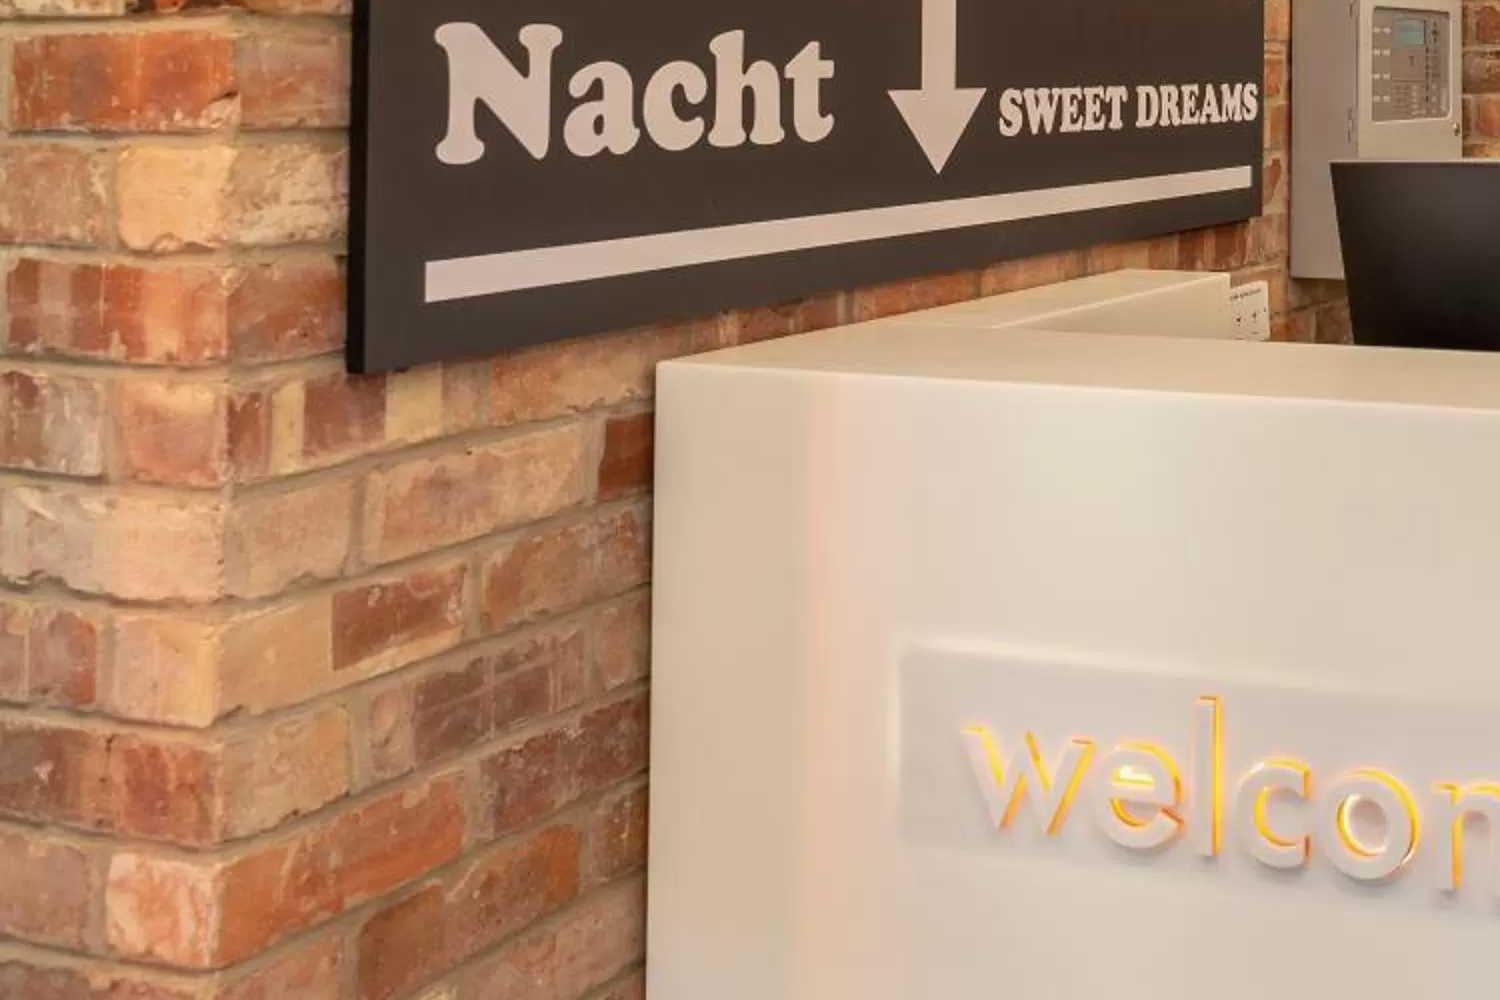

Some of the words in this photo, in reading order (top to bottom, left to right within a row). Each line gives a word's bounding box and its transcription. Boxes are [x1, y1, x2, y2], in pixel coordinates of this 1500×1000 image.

[434, 21, 835, 165] Nacht
[999, 85, 1127, 137] SWEET
[1135, 83, 1259, 128] DREAMS
